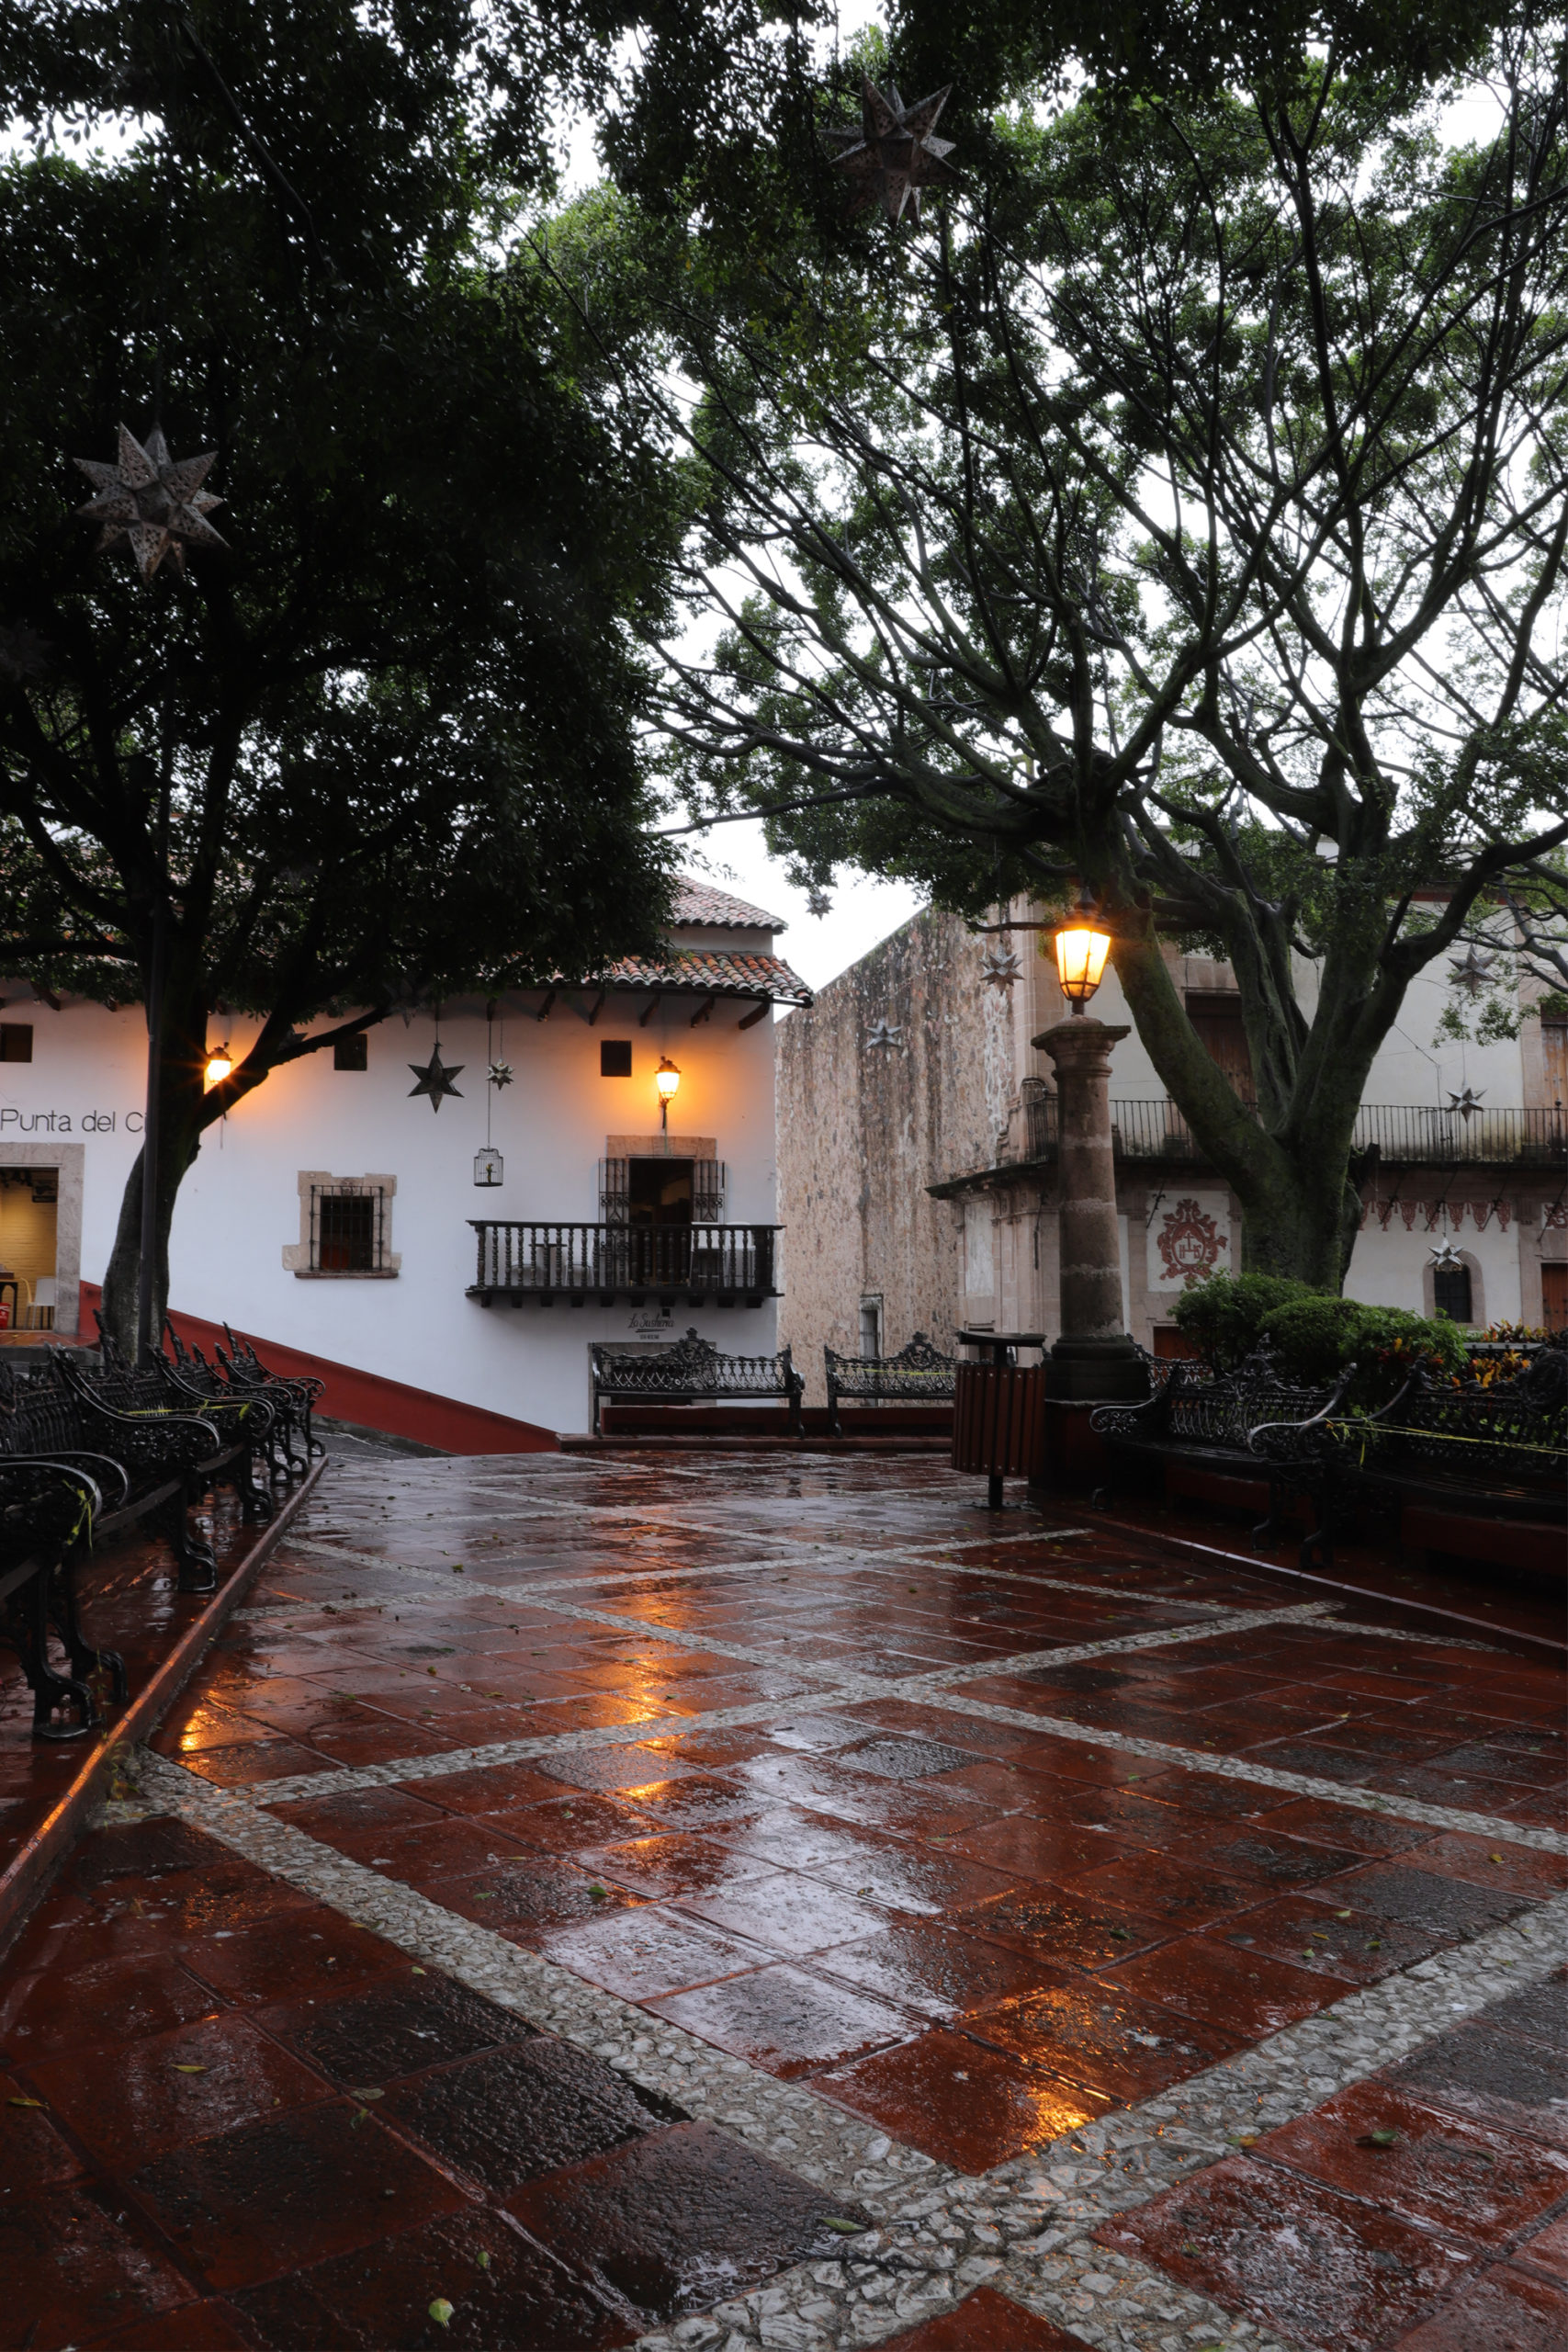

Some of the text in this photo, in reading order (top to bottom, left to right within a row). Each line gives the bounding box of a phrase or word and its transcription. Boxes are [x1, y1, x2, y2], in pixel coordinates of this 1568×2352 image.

[0, 1108, 73, 1133] Punta
[81, 1109, 116, 1133] del
[627, 1312, 638, 1329] La
